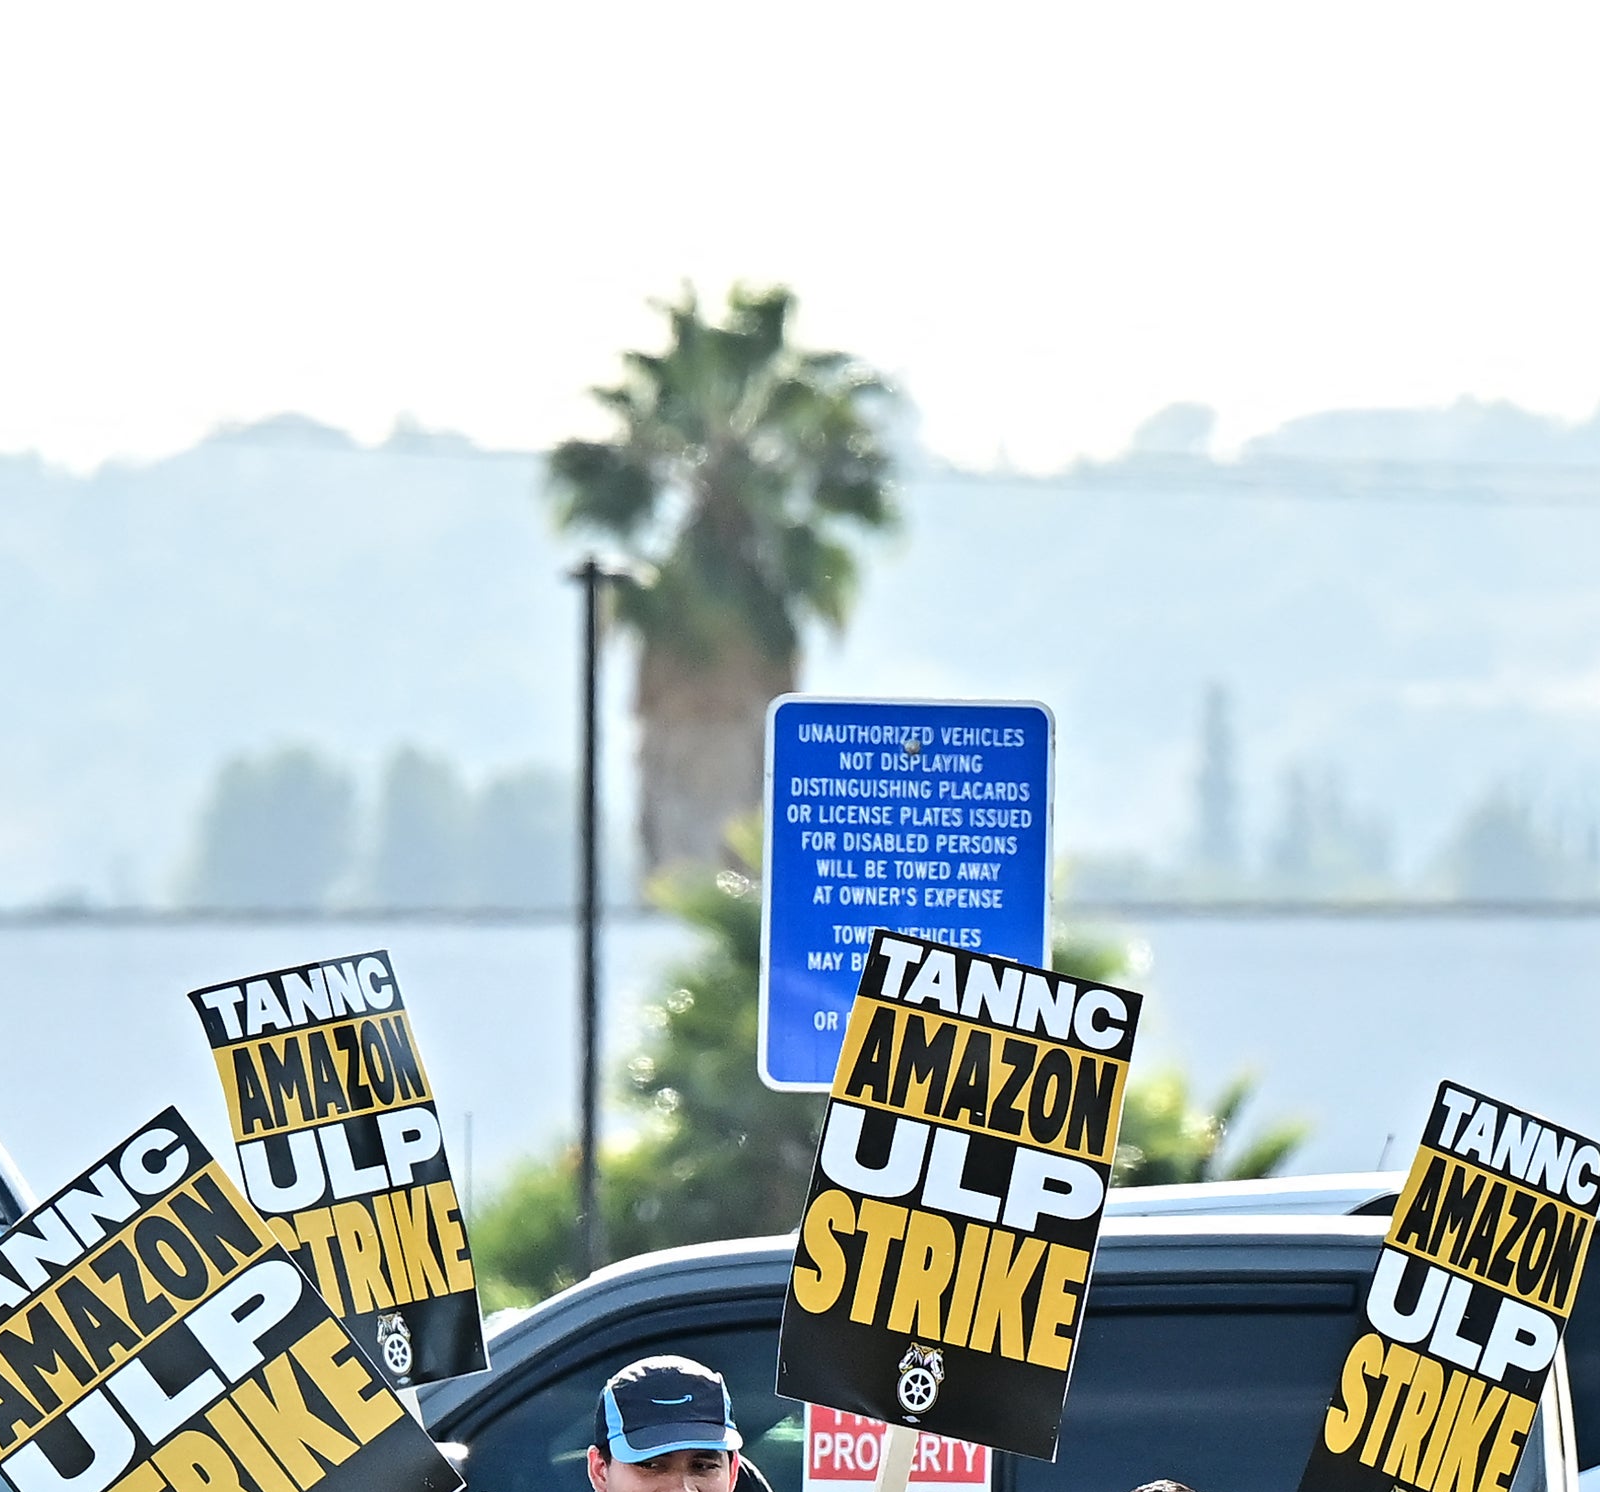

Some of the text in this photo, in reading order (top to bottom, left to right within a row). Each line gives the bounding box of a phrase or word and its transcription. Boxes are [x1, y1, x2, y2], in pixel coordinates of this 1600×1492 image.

[798, 724, 1024, 747] UNAUTHORIZED VEHICLES
[839, 752, 983, 773] NOT DISPLAYING
[791, 778, 1030, 802] DISTINGUISHING PLACARDS
[787, 806, 1032, 829] OR LICENSE PLATES ISSUED
[801, 832, 1017, 855] FOR DISABLED PERSONS
[816, 859, 1001, 881] WILL BE TOWED AWAY
[812, 886, 1004, 909] AT OWNER'S EXPENSE
[833, 925, 889, 944] TOWE
[808, 952, 869, 971] MAY B
[200, 956, 396, 1040] TANNC
[878, 937, 1128, 1050] TANNC
[814, 1011, 837, 1031] OR
[237, 1015, 426, 1136] AMAZON
[845, 1006, 1118, 1156] AMAZON
[237, 1106, 441, 1214] ULP
[820, 1101, 1104, 1233] ULP
[1394, 1155, 1592, 1310] AMAZON
[792, 1188, 1089, 1372] STRIKE
[1366, 1248, 1558, 1382] ULP
[813, 1432, 978, 1474] PRORTY
